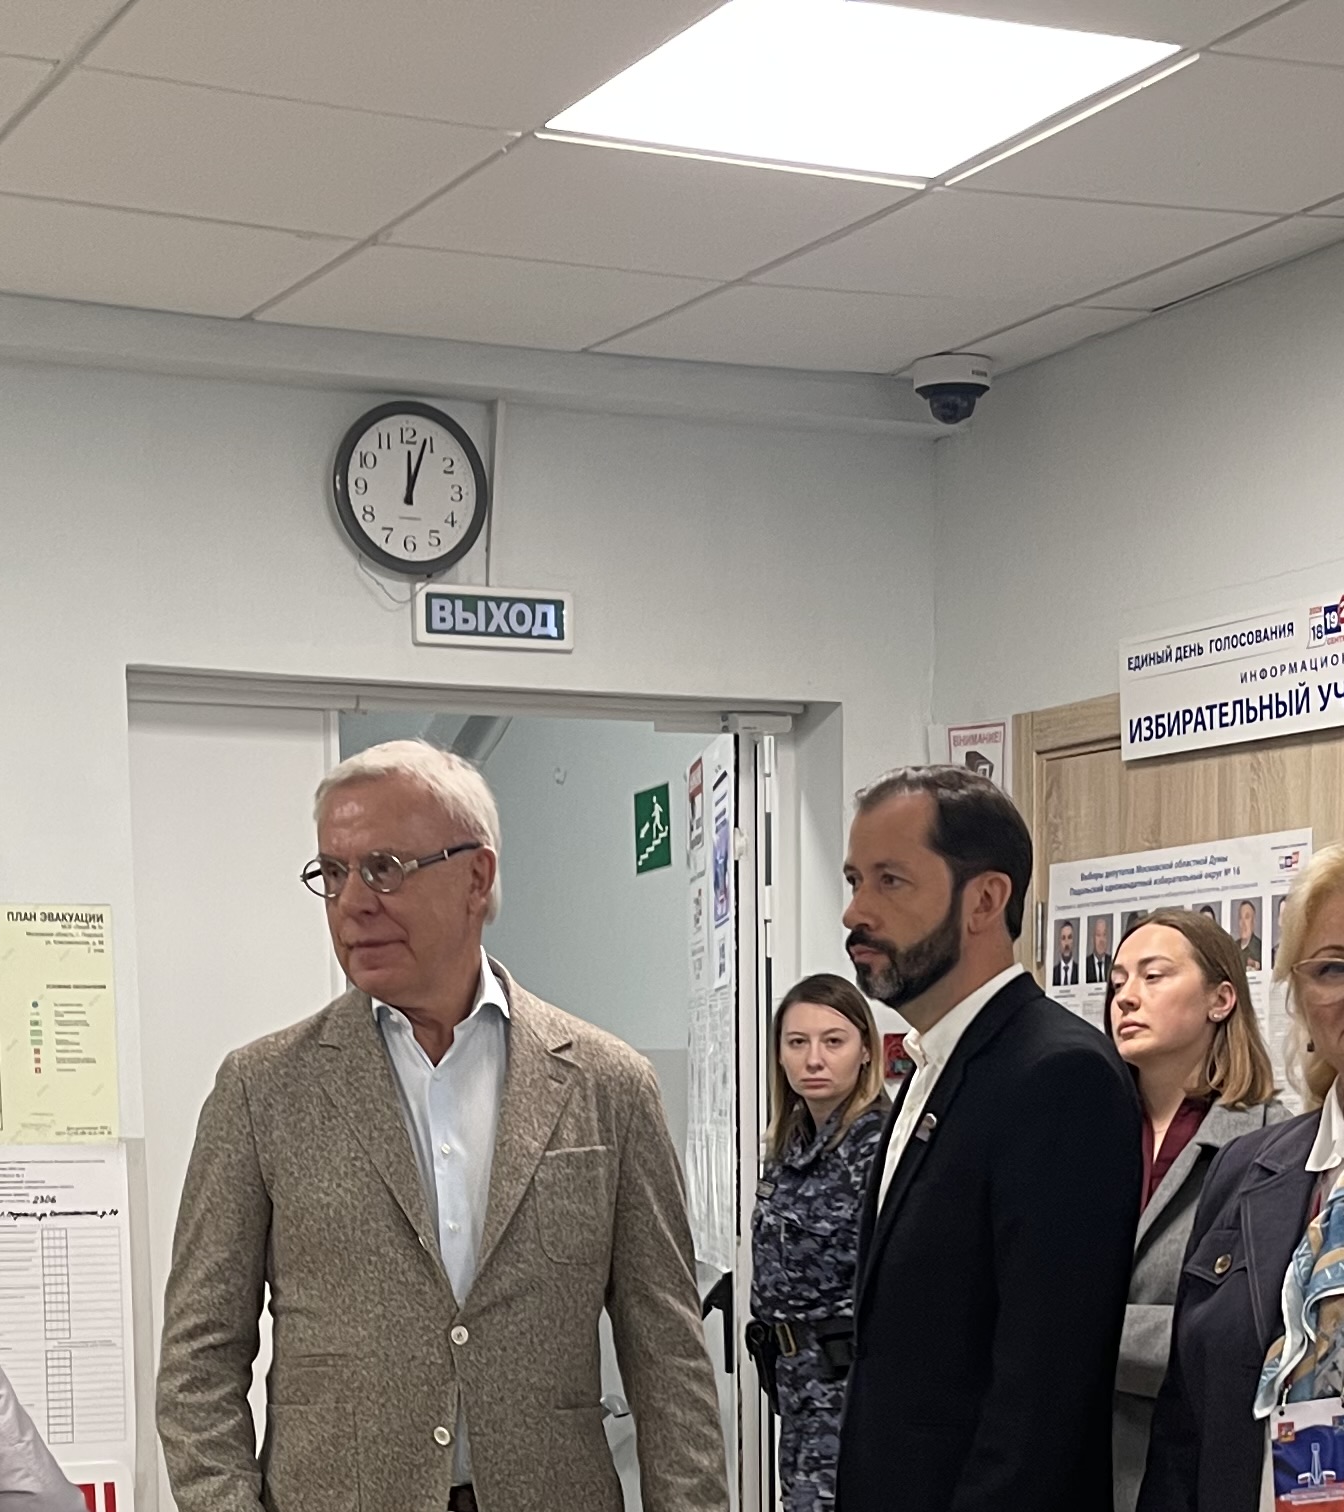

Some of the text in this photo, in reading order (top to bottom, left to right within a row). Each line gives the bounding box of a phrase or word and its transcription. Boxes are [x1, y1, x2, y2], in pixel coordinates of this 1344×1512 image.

[378, 432, 391, 450] 11
[399, 427, 417, 445] 12
[359, 451, 377, 469] 10
[442, 457, 455, 475] 2
[354, 477, 368, 495] 9
[450, 484, 463, 502] 3
[362, 504, 376, 522] 8
[444, 511, 457, 527] 4
[381, 527, 394, 545] 7
[403, 535, 417, 552] 6
[428, 530, 441, 547] 5
[432, 598, 558, 637] ВЫХОД
[1311, 624, 1324, 641] 18
[1325, 611, 1339, 629] 19
[1127, 622, 1295, 672] ЕДИНЫЙ ДЕНЬ ГОЛОСОВАНИЯ
[1129, 681, 1311, 744] ИЗБИРАТЕЛЬНЫЙ
[6, 911, 104, 924] ПЛАН ЭВАКУАЦИИ
